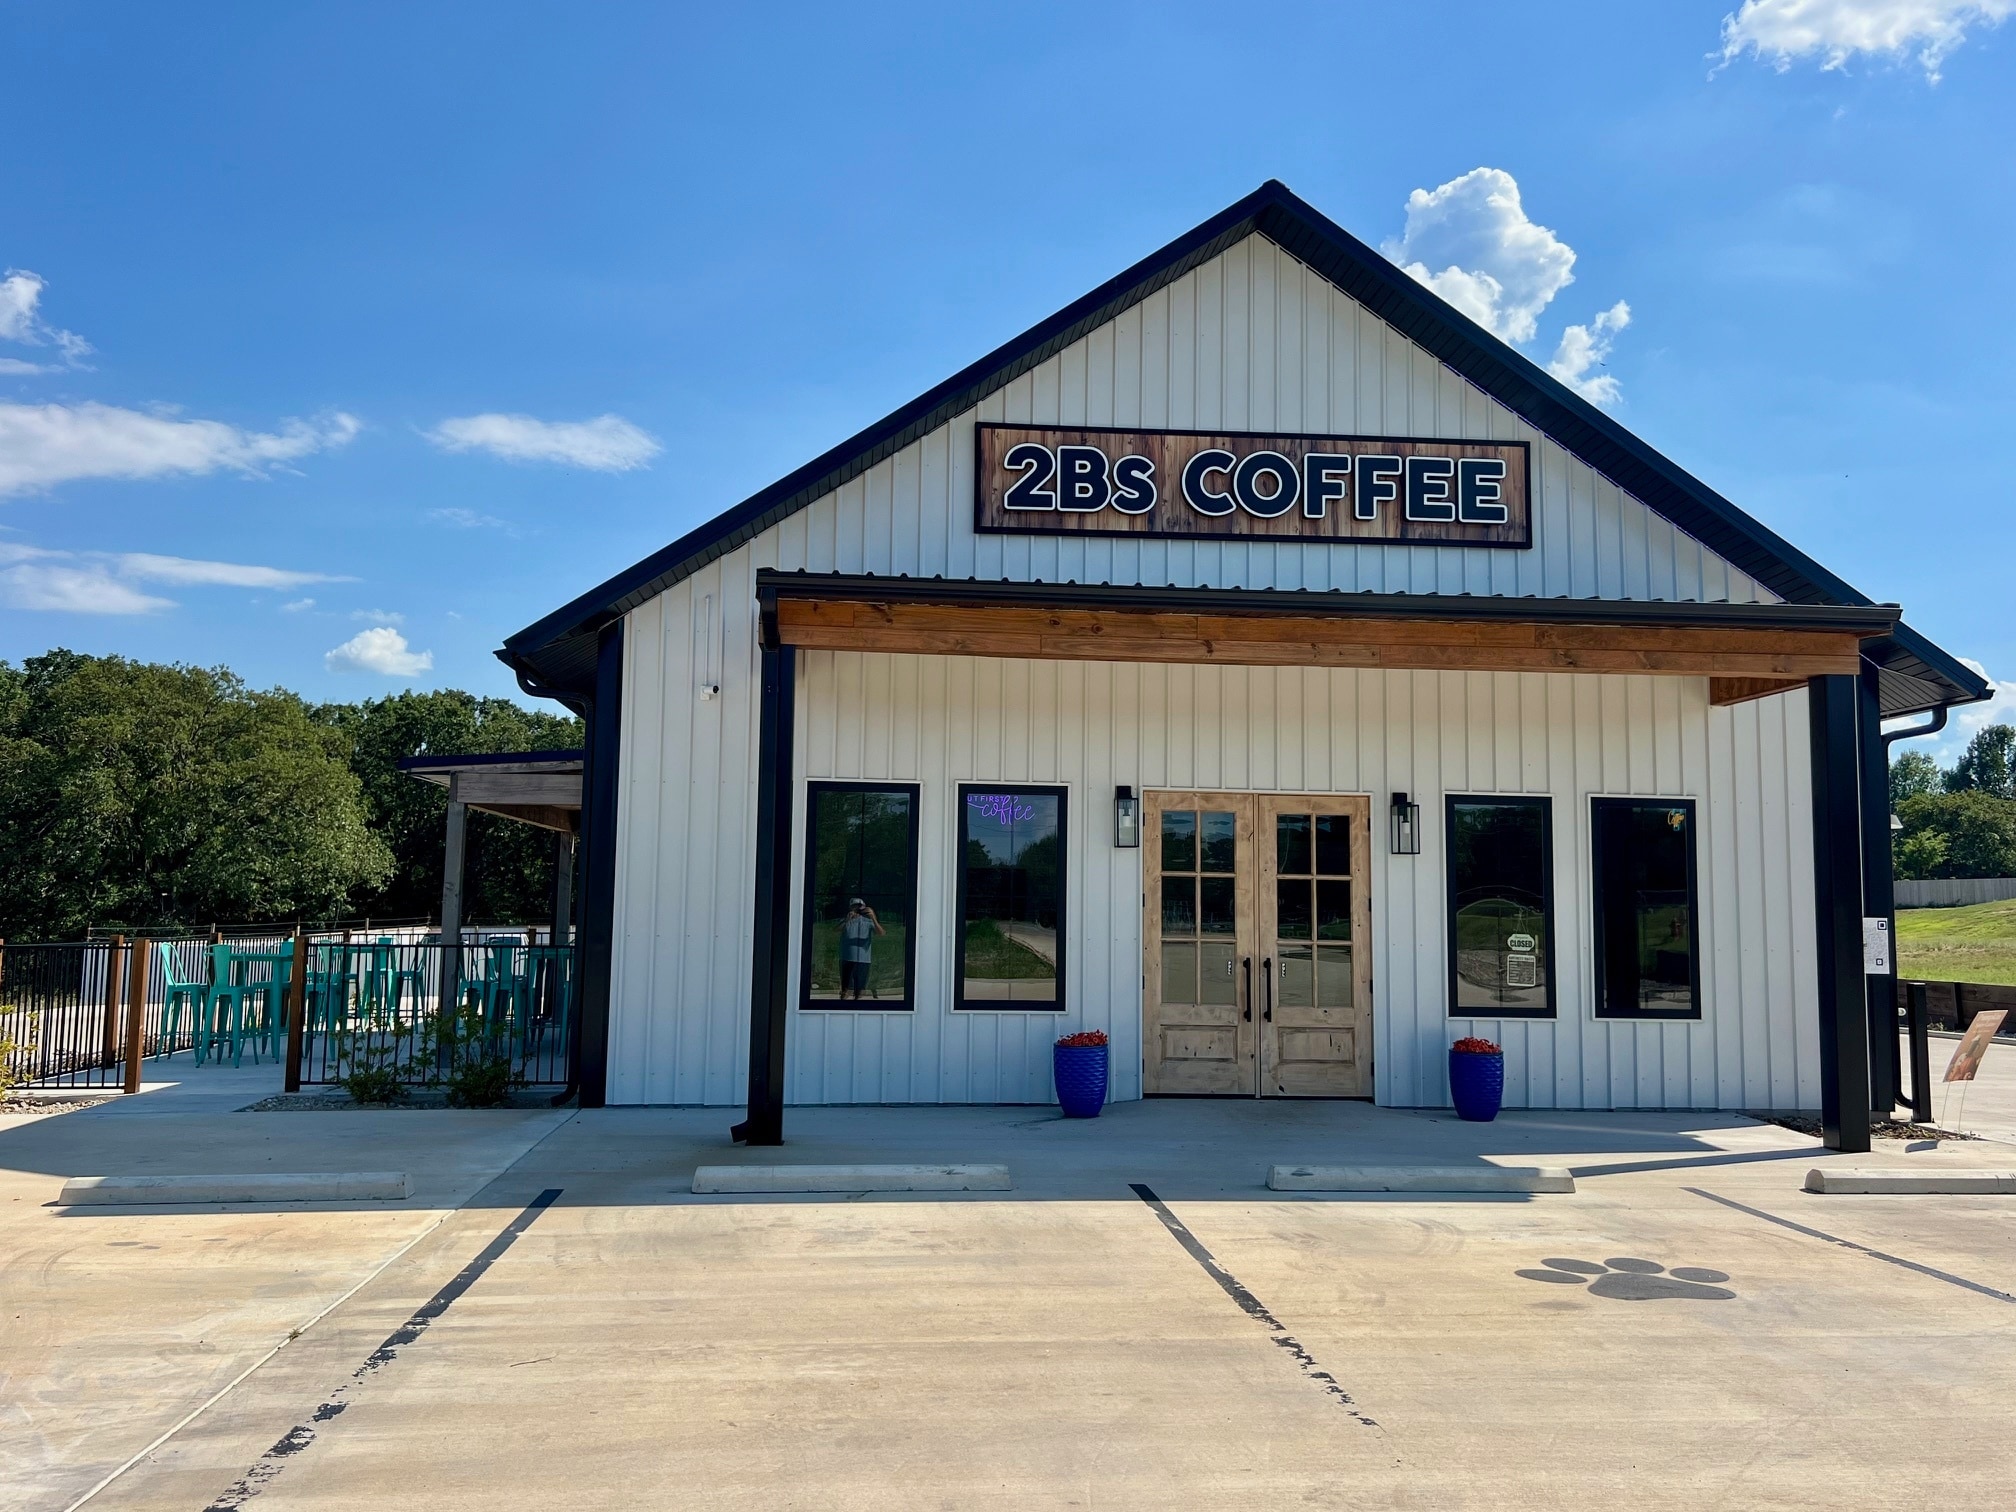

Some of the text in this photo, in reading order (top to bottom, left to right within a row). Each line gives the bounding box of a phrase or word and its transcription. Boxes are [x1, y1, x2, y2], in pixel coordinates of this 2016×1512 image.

[1003, 442, 1508, 524] 2Bs COFFEE
[980, 795, 1004, 803] FIRST
[980, 795, 1035, 825] coffee
[1510, 940, 1533, 948] CLOSED
